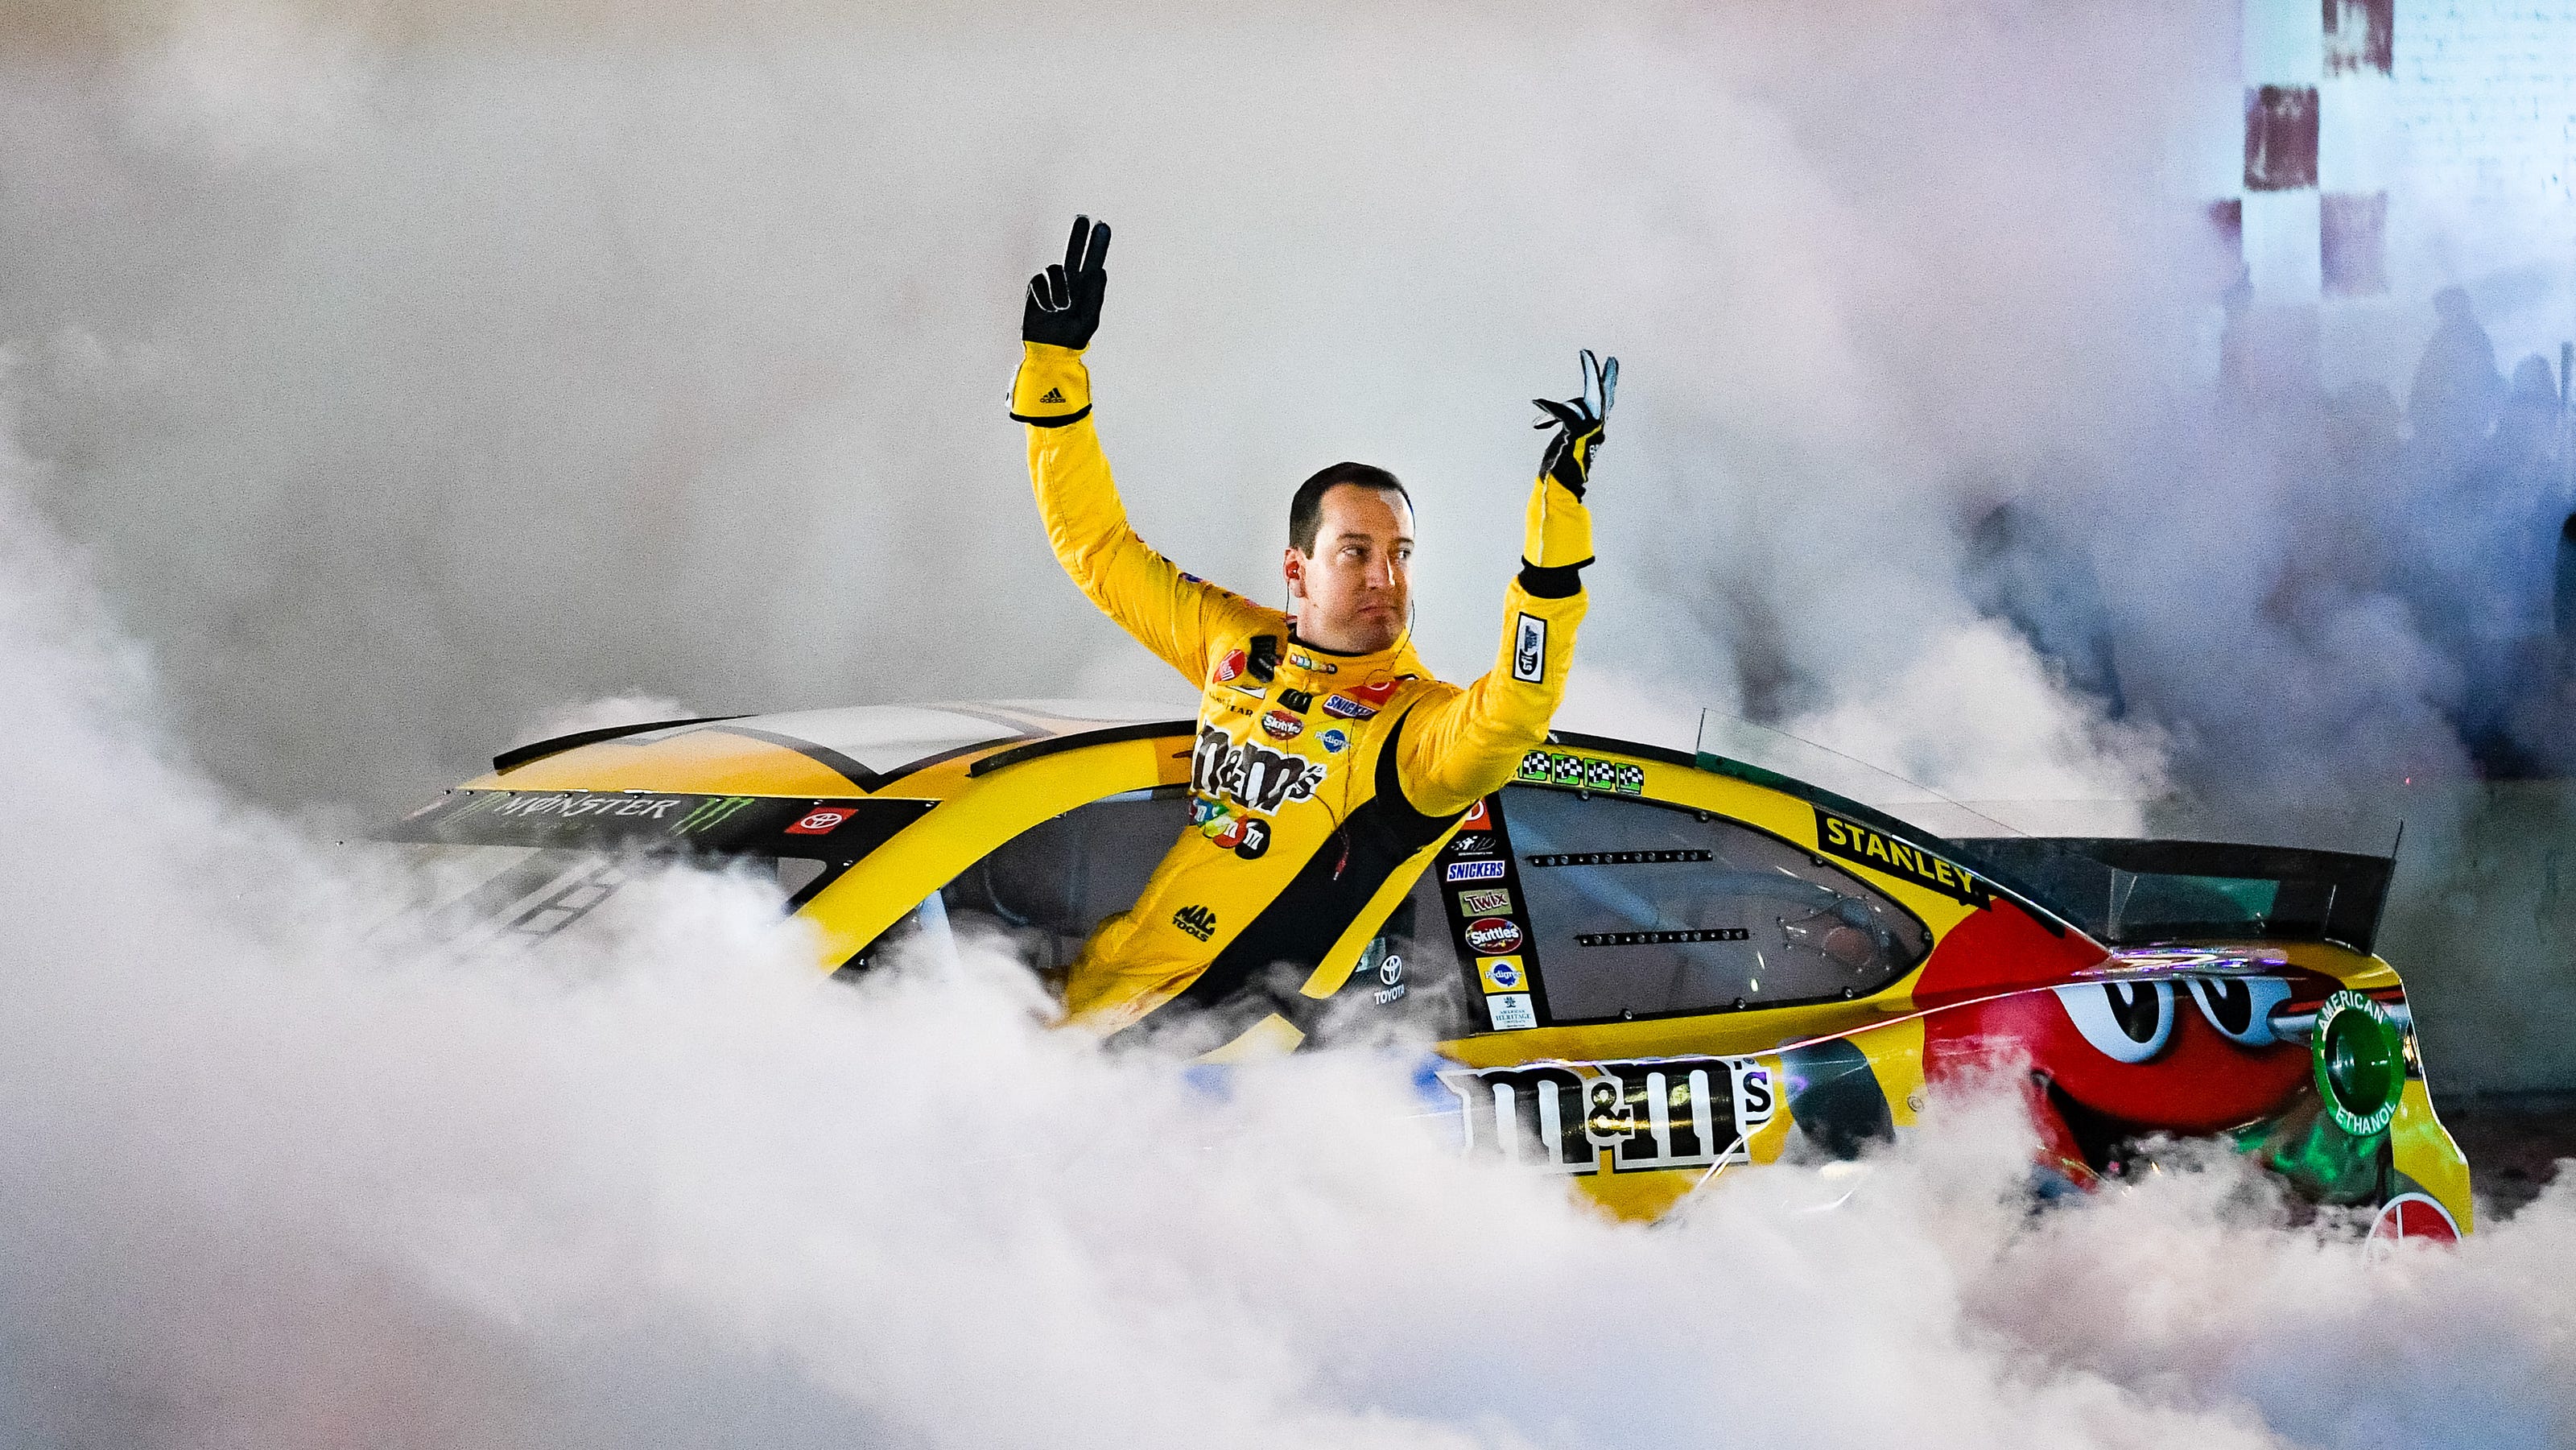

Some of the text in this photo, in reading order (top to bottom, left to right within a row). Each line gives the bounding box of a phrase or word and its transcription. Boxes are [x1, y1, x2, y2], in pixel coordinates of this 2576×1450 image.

[493, 794, 681, 819] MONSTER
[1826, 817, 1973, 894] STANLEY
[1448, 862, 1504, 880] SNICKERS
[1172, 917, 1208, 942] TOOLS
[1174, 905, 1216, 936] MAC
[1471, 927, 1519, 944] Skittles
[1374, 984, 1405, 1005] TOYOTA
[2318, 989, 2384, 1031] AMERICAN
[2335, 1101, 2396, 1134] ETHANOL
